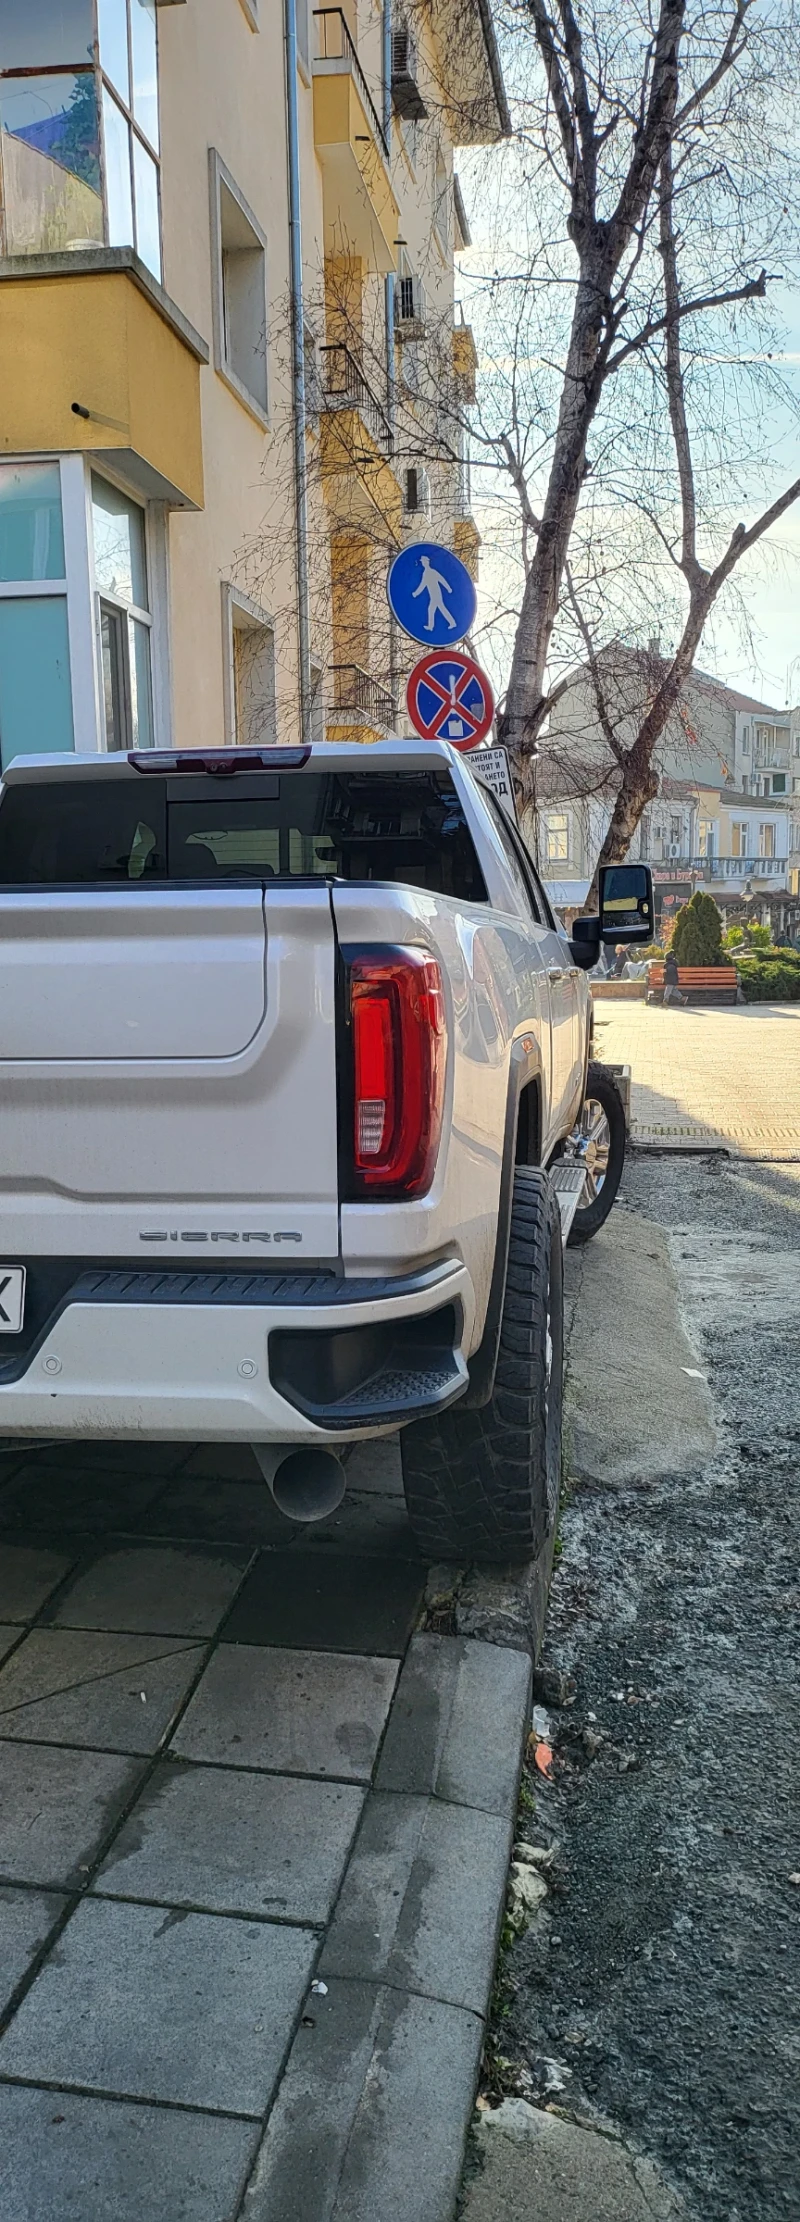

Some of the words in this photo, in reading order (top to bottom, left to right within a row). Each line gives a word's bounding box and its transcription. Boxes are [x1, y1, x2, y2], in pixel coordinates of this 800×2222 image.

[494, 751, 503, 759] СА
[475, 762, 493, 771] ТОЯТ
[495, 761, 501, 769] И
[139, 1230, 303, 1243] SIERRA
